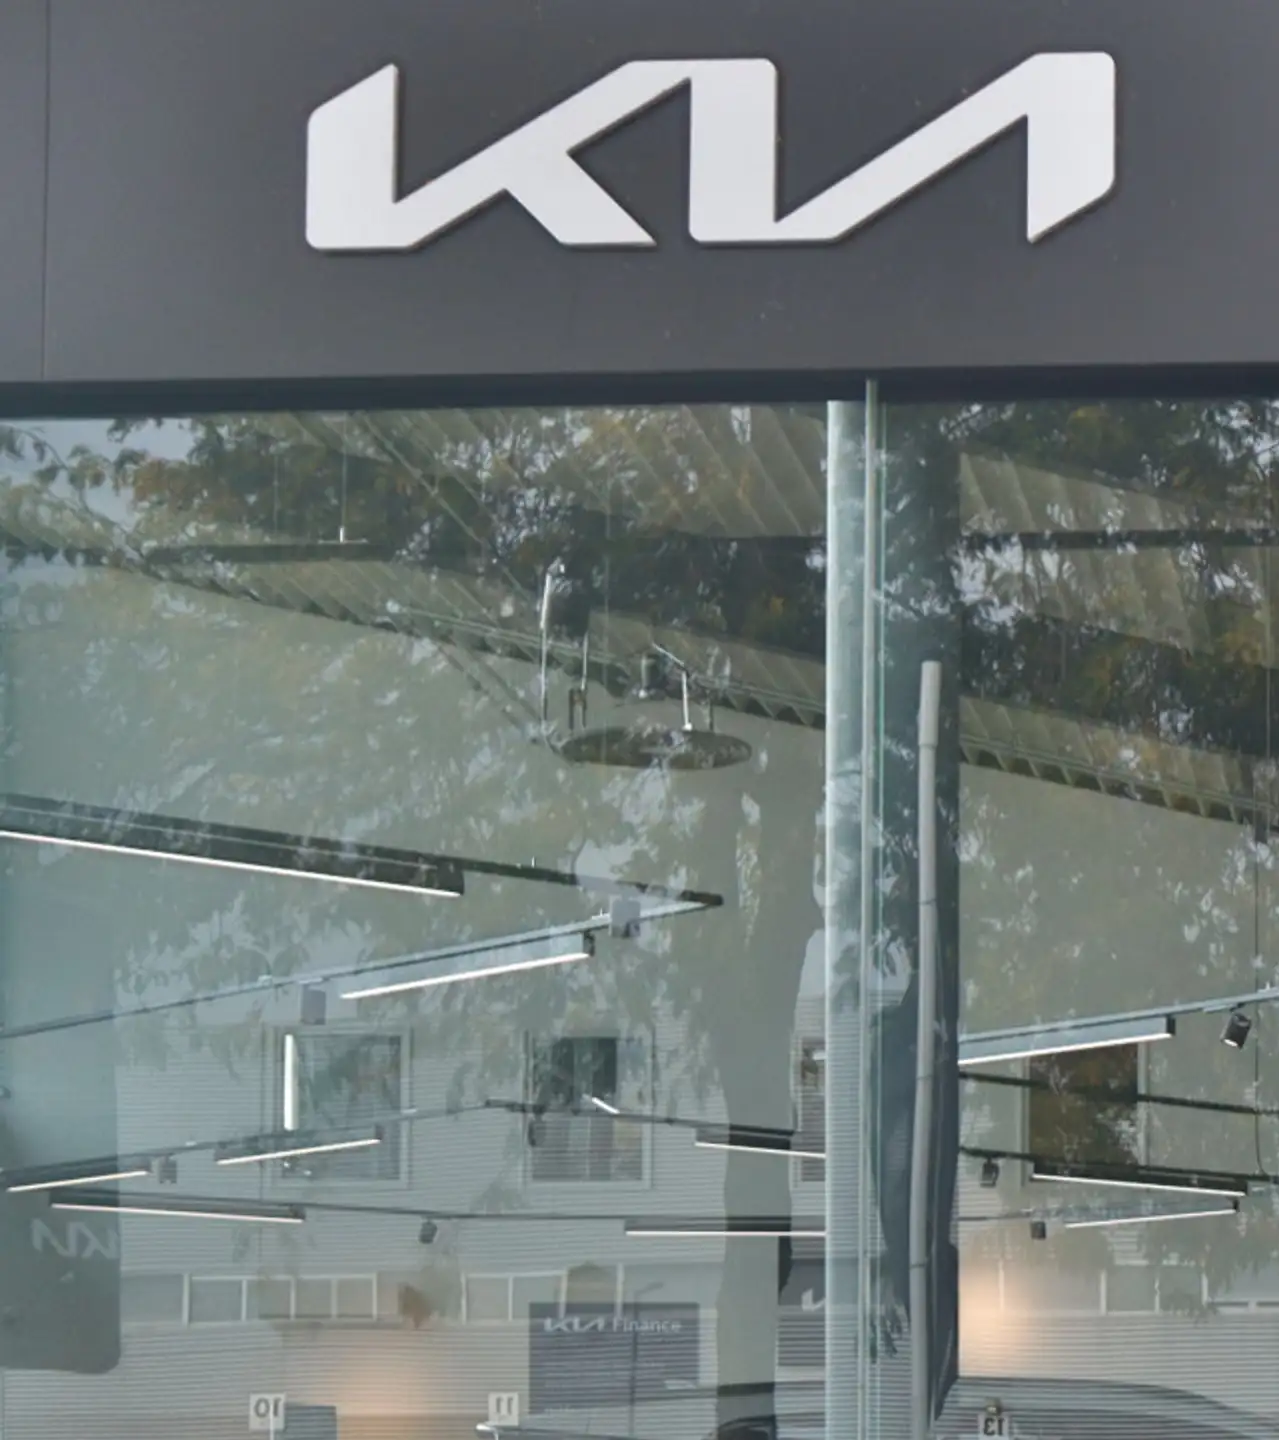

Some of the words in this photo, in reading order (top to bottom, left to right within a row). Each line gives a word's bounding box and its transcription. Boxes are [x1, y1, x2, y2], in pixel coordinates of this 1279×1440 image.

[306, 51, 1116, 250] KIA
[543, 1316, 605, 1332] KIA
[612, 1316, 683, 1333] Finance
